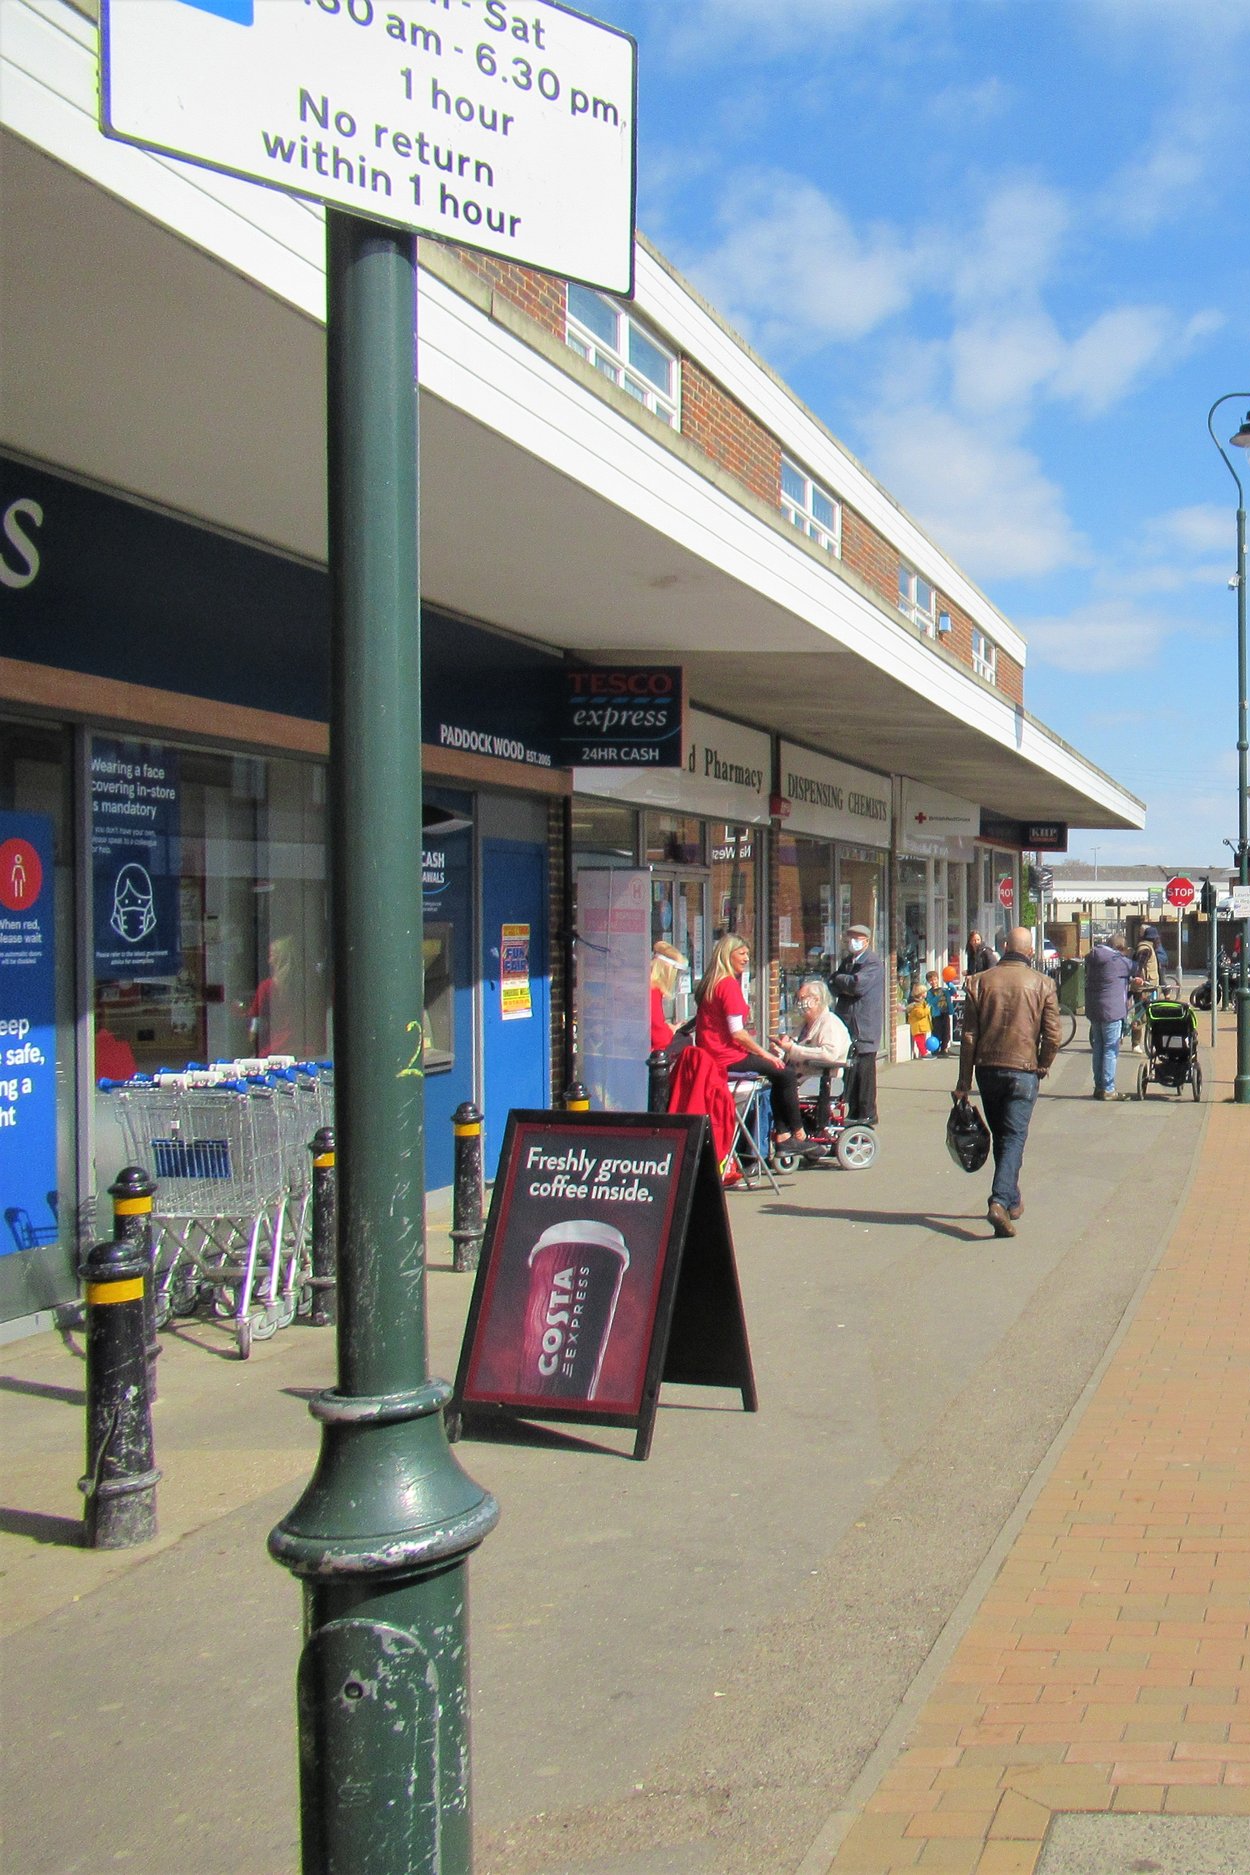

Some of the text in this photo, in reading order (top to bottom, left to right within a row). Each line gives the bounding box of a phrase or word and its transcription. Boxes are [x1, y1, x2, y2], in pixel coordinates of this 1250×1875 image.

[483, 0, 546, 51] Sat
[386, 13, 442, 57] am
[475, 42, 561, 101] 6.30
[400, 66, 515, 137] 1 hour
[299, 86, 494, 187] No return
[260, 129, 522, 239] within 1 hour
[568, 672, 673, 695] TESCO
[573, 707, 668, 733] express
[440, 723, 493, 754] PADDOCK
[493, 735, 525, 761] WOOD
[582, 747, 660, 761] 24HR CASH
[91, 758, 166, 780] Wearing a face
[704, 747, 764, 794] Pharmacy
[137, 781, 176, 800] in-store
[787, 773, 887, 822] DISPENSING CHEMISTS
[101, 801, 158, 820] mandatory
[1167, 887, 1194, 897] STOP
[0, 1018, 30, 1040] eep
[6, 1042, 46, 1066] safe,
[21, 1077, 32, 1094] a
[526, 1146, 672, 1182] Freshly ground
[529, 1174, 654, 1202] coffee inside.
[538, 1267, 575, 1377] COSTA
[565, 1266, 590, 1358] EXPRESS
